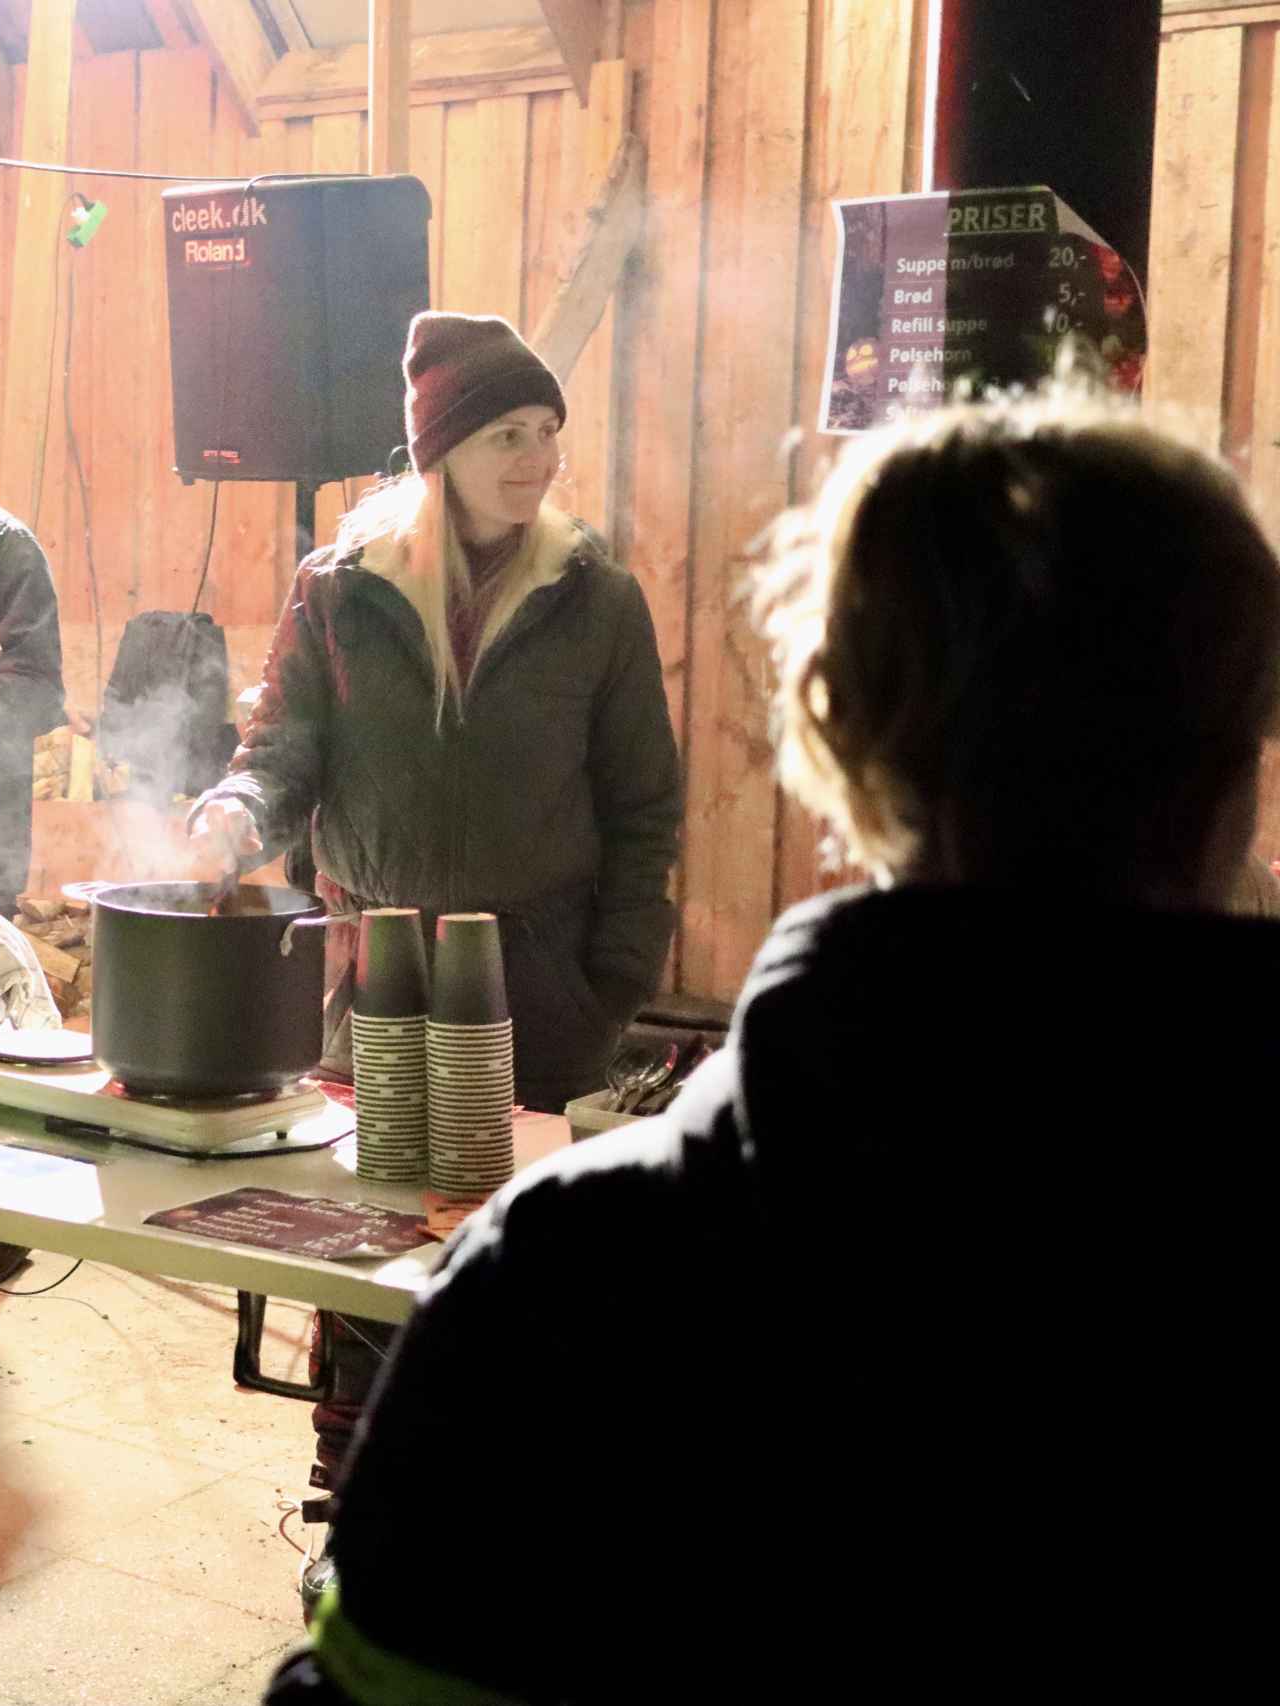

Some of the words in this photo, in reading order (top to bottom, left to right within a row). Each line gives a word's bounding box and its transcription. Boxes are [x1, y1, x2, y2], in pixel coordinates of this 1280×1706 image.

[946, 202, 1047, 232] PRISER
[896, 257, 946, 276] Suppe
[951, 252, 1014, 271] m/brød
[1047, 246, 1087, 269] 20,-
[893, 287, 933, 304] Brød
[1058, 282, 1086, 305] 5,-
[891, 317, 933, 334] Refill
[936, 318, 988, 336] suppe
[889, 346, 972, 362] Pølsehorn
